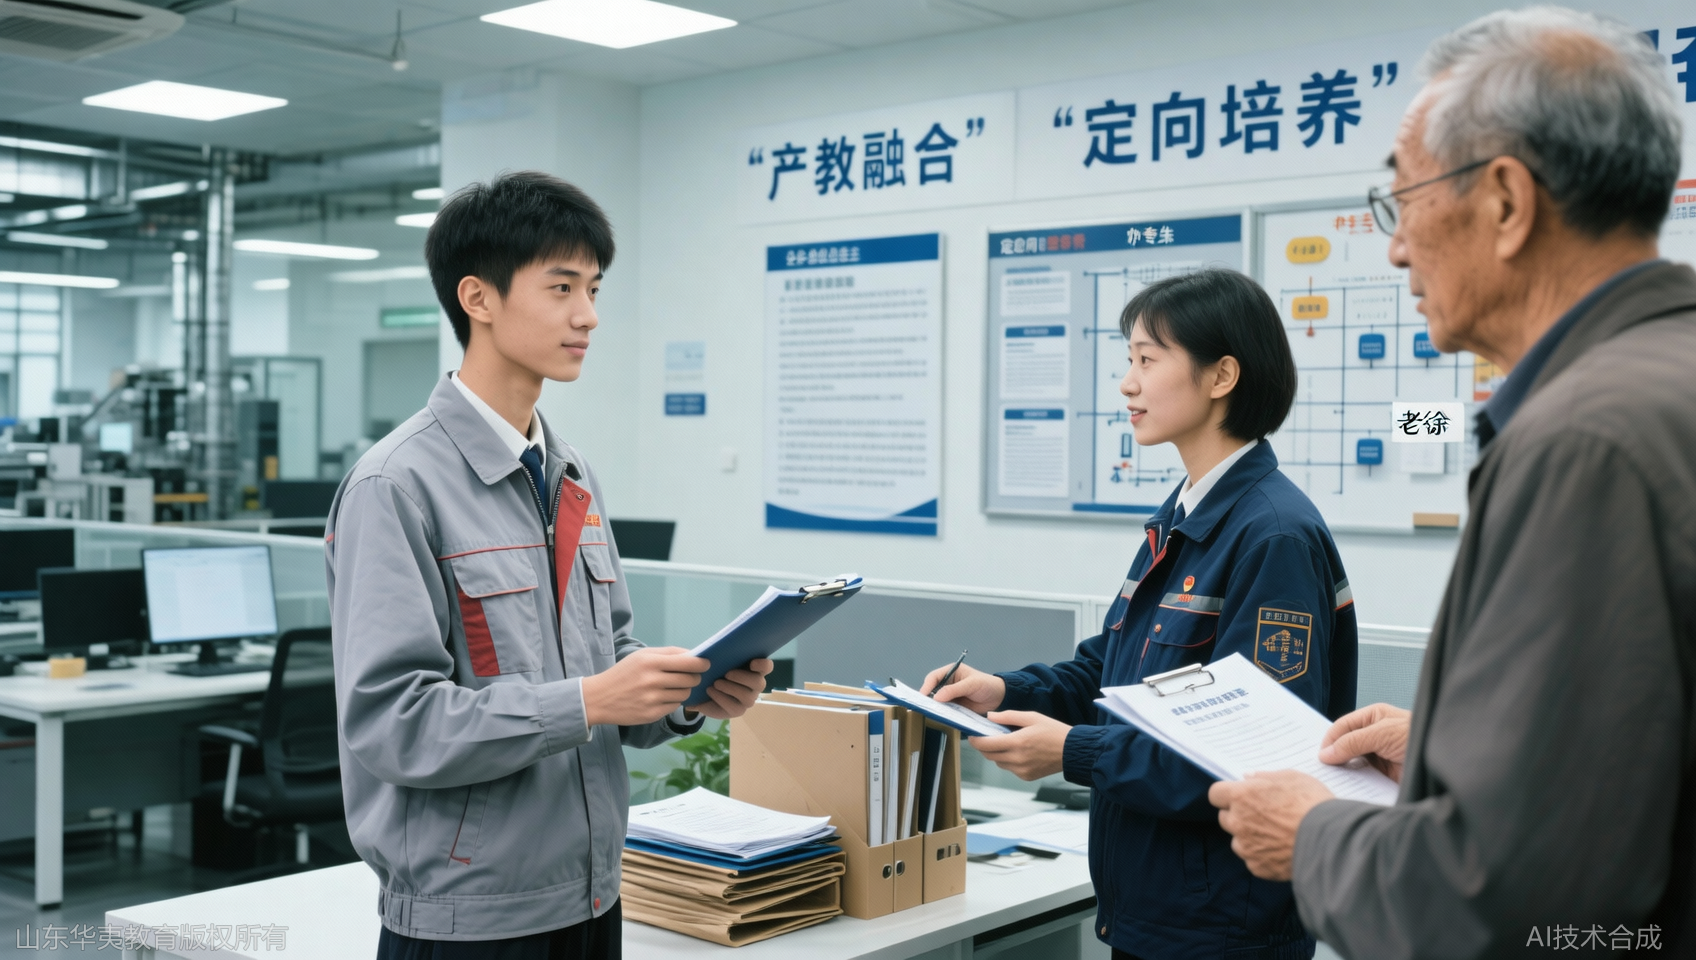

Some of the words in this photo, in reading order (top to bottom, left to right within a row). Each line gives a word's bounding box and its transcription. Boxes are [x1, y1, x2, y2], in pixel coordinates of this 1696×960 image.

[748, 117, 985, 201] “产教融合”
[1053, 62, 1398, 168] “定向培养”
